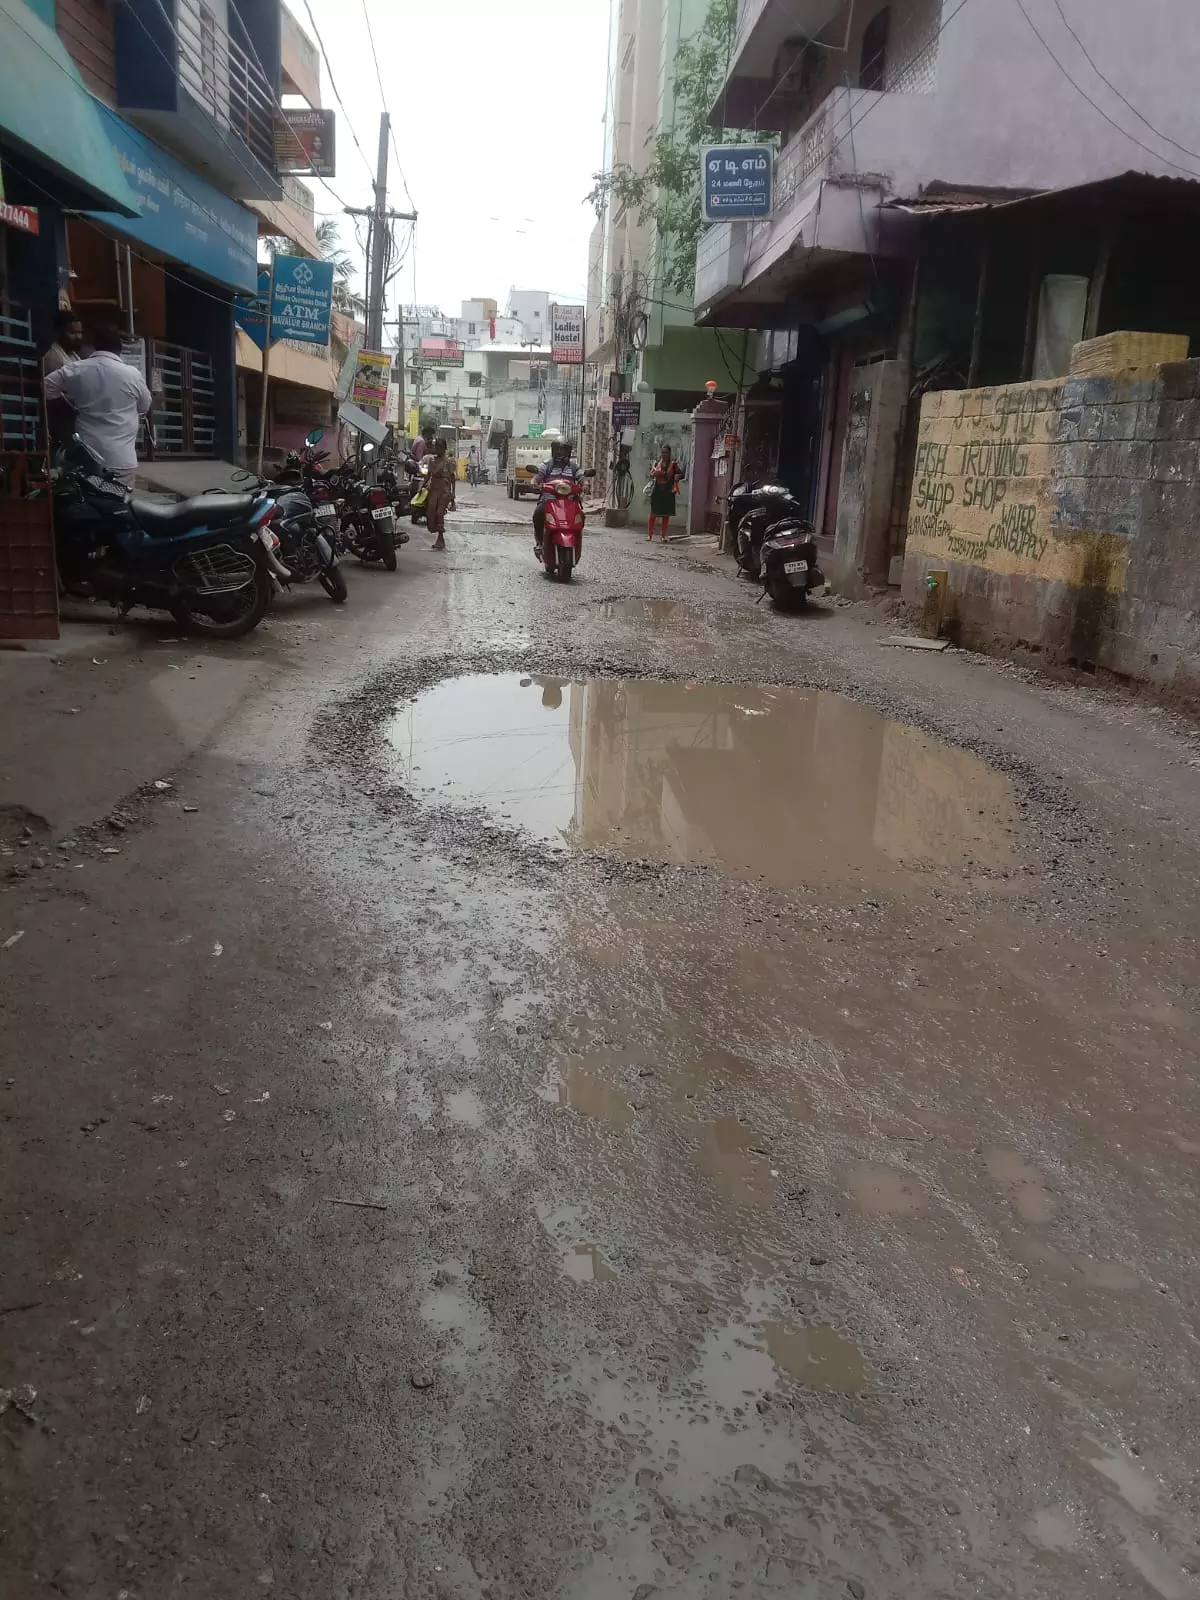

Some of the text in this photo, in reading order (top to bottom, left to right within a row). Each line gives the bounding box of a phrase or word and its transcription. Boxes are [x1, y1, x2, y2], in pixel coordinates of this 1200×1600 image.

[709, 154, 766, 175] ஏ டி எம்
[711, 179, 721, 188] 24
[281, 304, 320, 321] ATM
[272, 315, 301, 328] NAVALUR
[301, 319, 328, 332] BRANCH
[554, 321, 581, 332] Ladies
[554, 332, 581, 343] Hostel
[915, 438, 1029, 479] FISH IRONING
[916, 477, 1006, 516] SHOP SHOP
[1002, 503, 1037, 537] WATER
